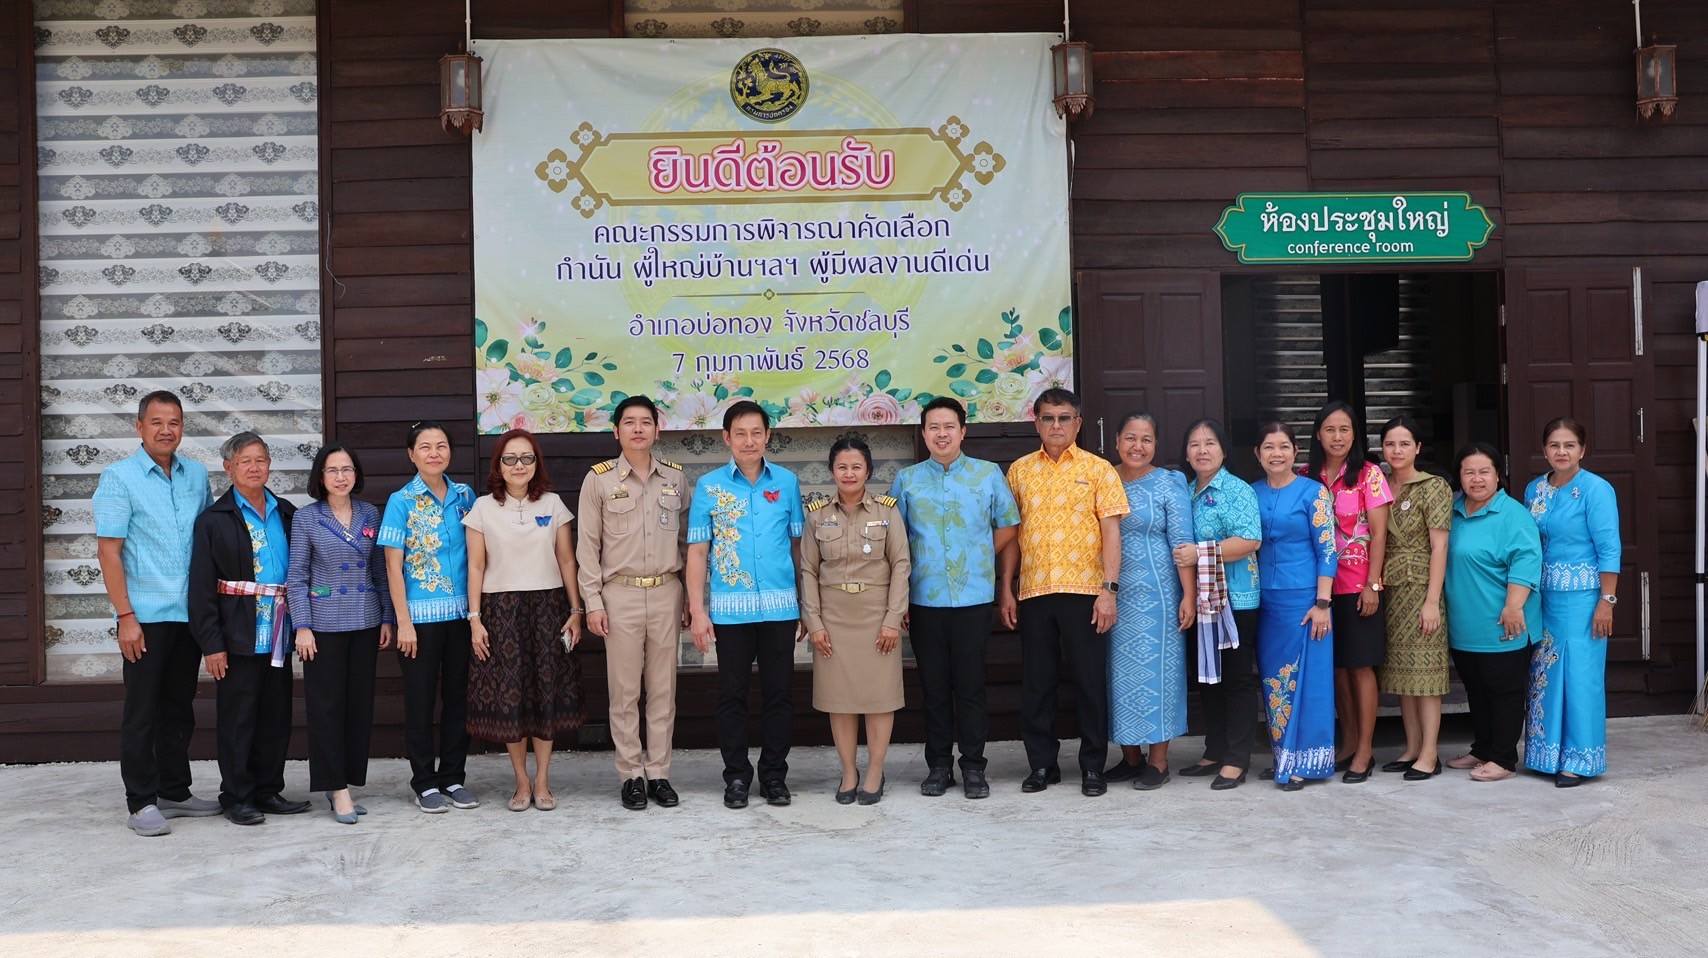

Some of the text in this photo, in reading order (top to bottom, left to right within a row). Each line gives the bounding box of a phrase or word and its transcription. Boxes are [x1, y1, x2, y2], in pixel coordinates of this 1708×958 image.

[650, 138, 893, 191] ยินดีต้อนรับ
[594, 212, 950, 244] คณะกรรมการพิจารณาคัดเลือก
[1260, 197, 1449, 243] ห้องประชุมใหญ่
[1287, 240, 1414, 256] conference room
[557, 247, 990, 287] กำนัน ผู้ใหญ่บ้านฯลฯ ผู้มีผลงานดีเด่น
[629, 307, 910, 339] อำเภอบ่อทอง จังหวัดชลบุรี
[672, 346, 869, 380] 7 กุมภาพันธ์ 2568
